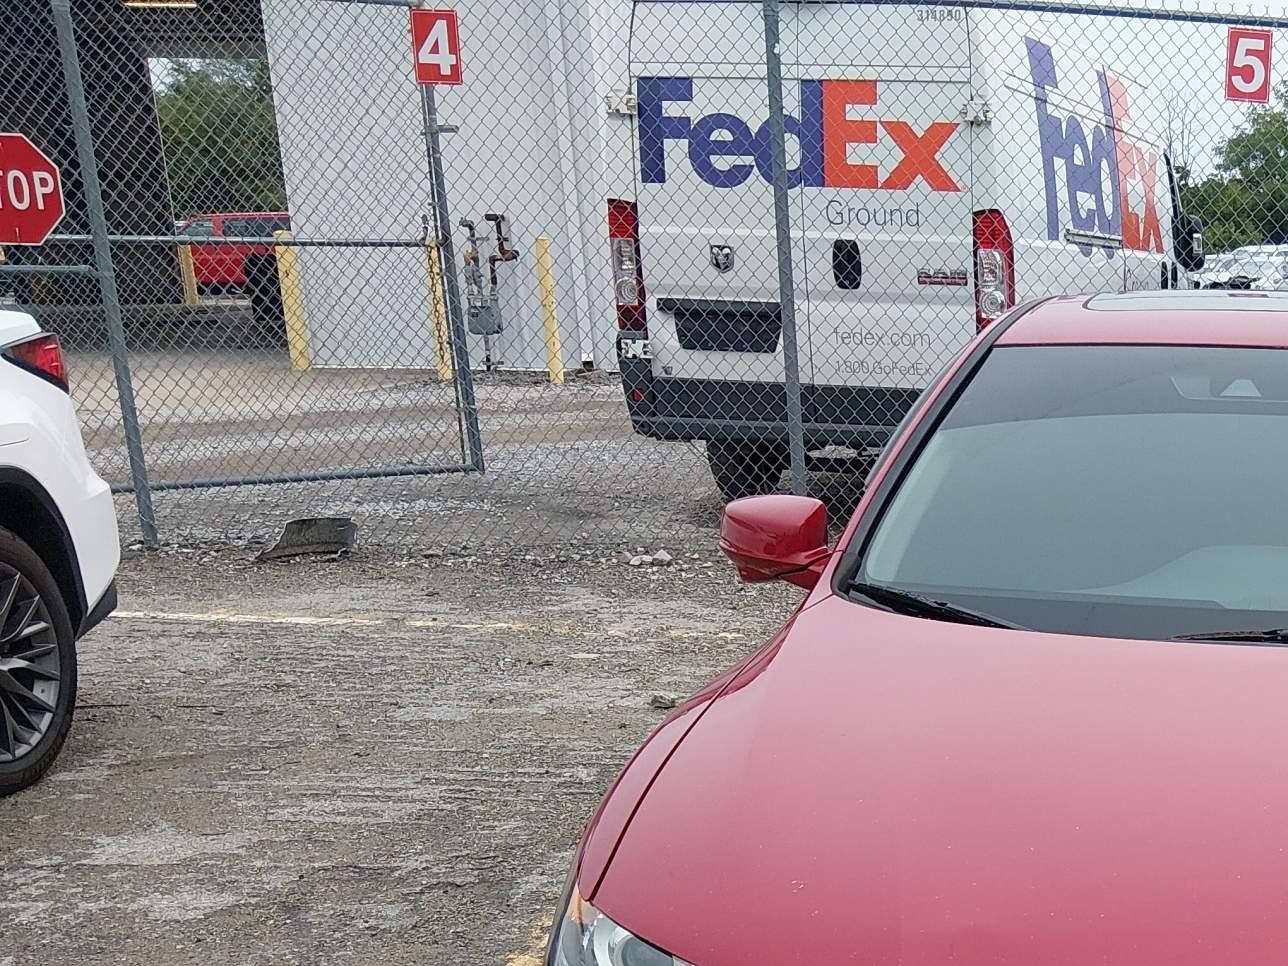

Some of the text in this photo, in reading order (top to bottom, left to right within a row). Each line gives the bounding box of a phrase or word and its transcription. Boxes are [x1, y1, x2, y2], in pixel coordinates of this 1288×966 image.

[417, 20, 457, 76] 4
[1231, 38, 1267, 94] 5
[637, 77, 962, 192] FedEx
[1024, 35, 1165, 260] FedEx
[826, 200, 920, 227] Ground
[833, 326, 931, 346] fedex.com
